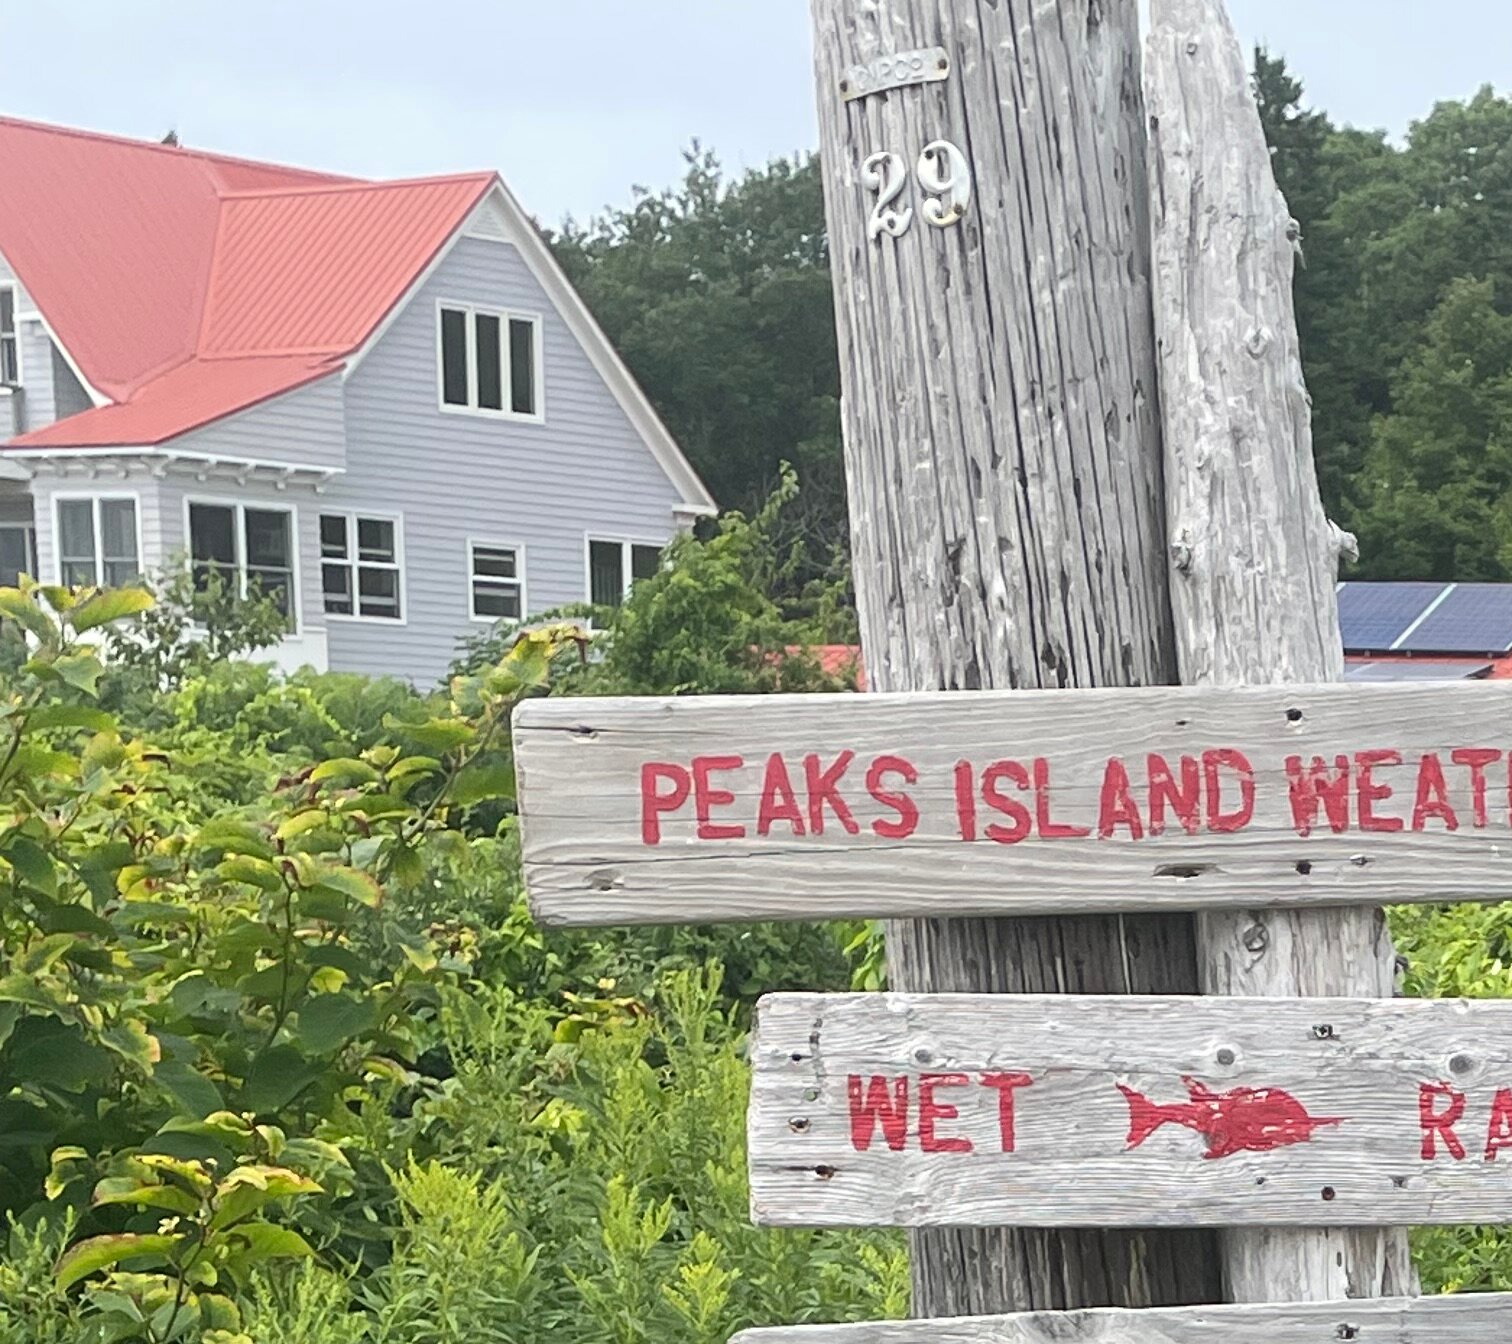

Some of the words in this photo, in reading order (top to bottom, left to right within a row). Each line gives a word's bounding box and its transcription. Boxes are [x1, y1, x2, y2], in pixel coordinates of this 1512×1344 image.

[861, 140, 970, 239] 29
[641, 750, 920, 845] PEAKS
[954, 748, 1256, 844] ISLAND
[847, 1071, 1034, 1153] WET
